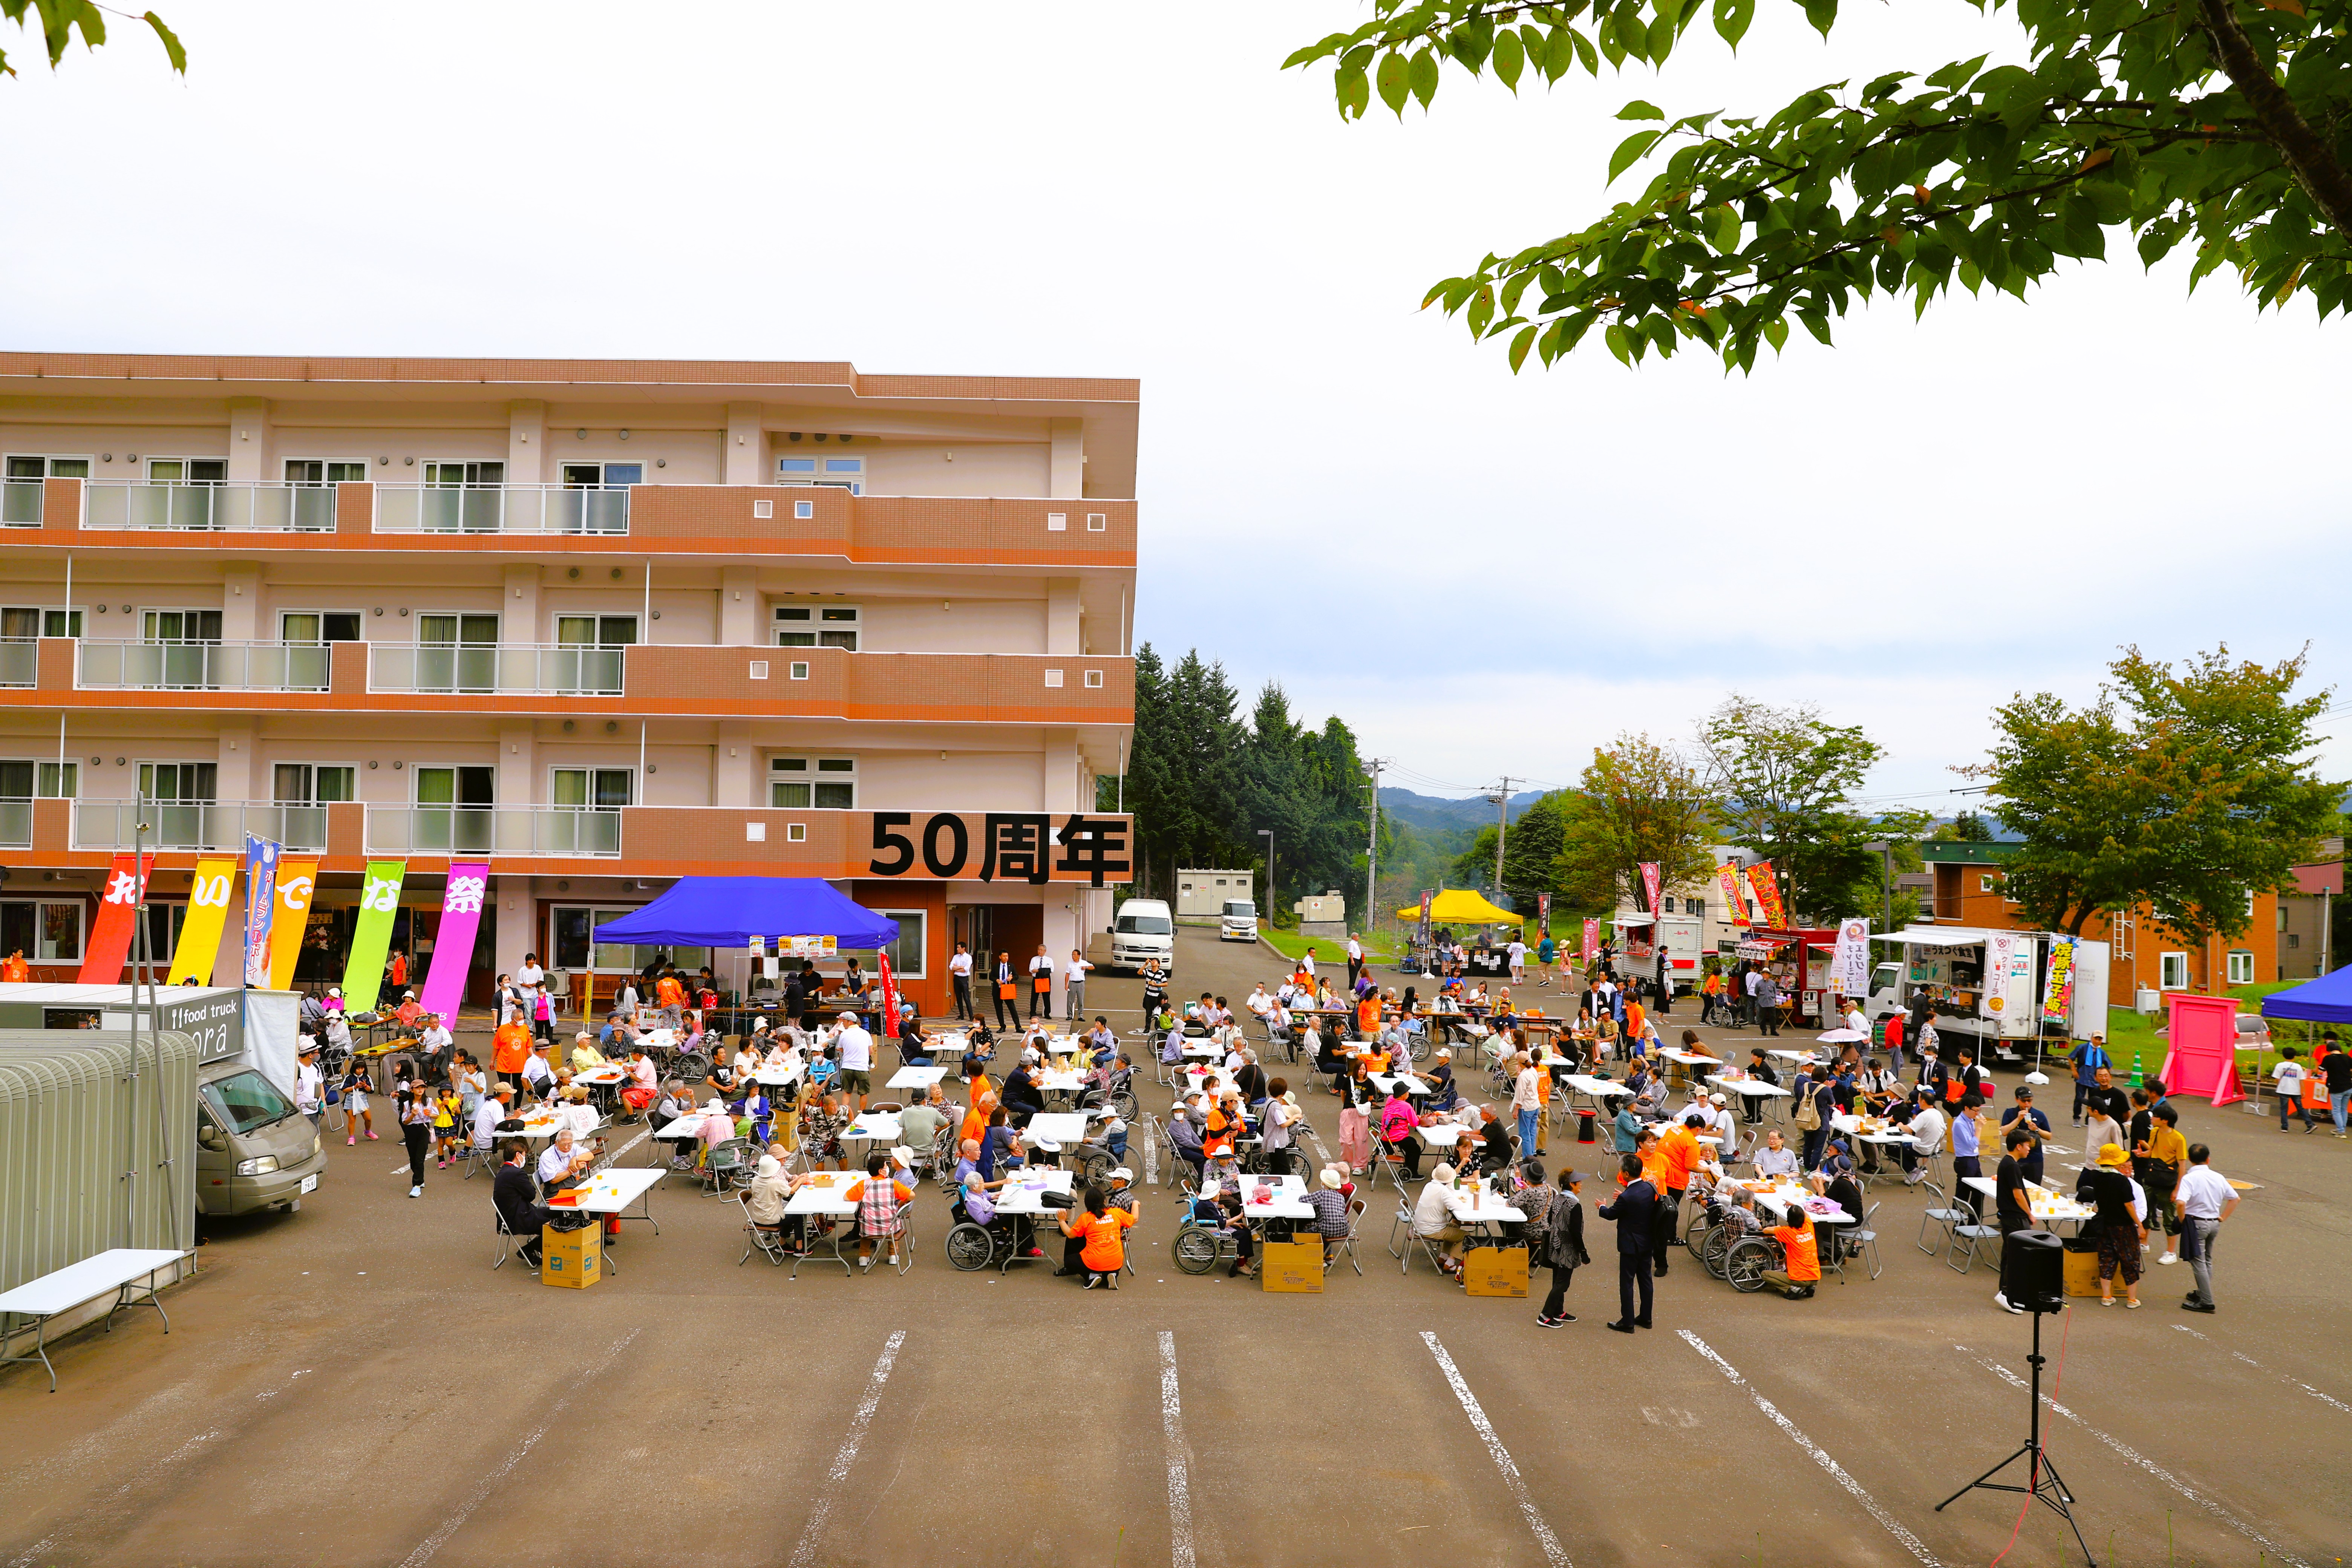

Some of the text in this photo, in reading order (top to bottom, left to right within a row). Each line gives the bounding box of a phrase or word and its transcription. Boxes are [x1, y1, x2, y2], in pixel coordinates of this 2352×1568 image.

[869, 812, 1130, 888] 50周年
[105, 871, 145, 905] お
[194, 875, 230, 907] い
[276, 876, 312, 910] で
[363, 876, 401, 913] な
[445, 875, 485, 914] 祭
[1932, 945, 1973, 958] うえつぐ食堂
[1992, 974, 2000, 995] コーラ
[2047, 943, 2073, 1014] 焼豚玉子飯
[184, 999, 236, 1024] food truck
